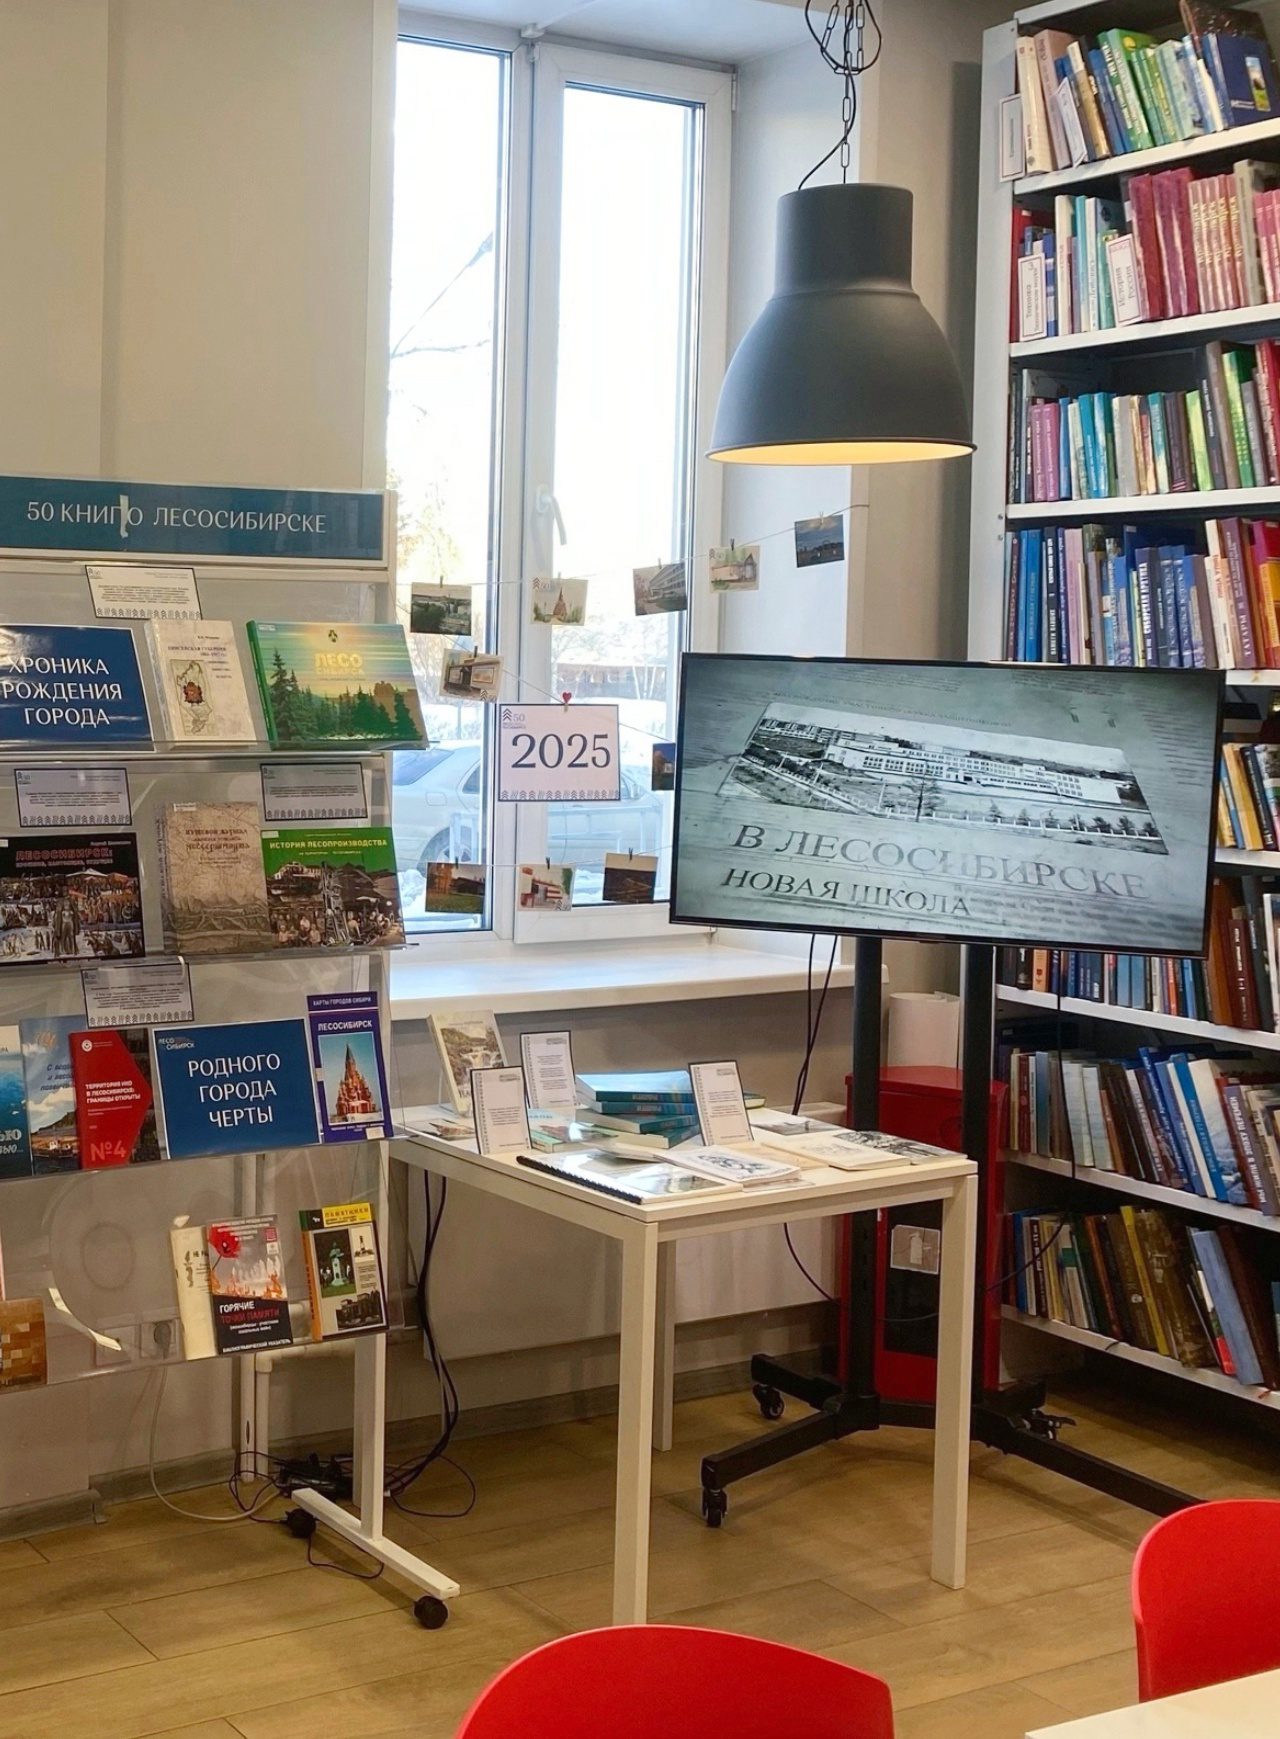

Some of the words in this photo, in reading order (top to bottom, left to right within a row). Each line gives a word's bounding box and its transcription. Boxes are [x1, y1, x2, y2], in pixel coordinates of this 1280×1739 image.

[27, 501, 54, 521] 50
[60, 503, 122, 525] КНИГ
[127, 509, 144, 527] О
[153, 506, 326, 534] ЛЕСОСИБИРСКЕ
[1239, 615, 1251, 656] ТАТАРЫ
[9, 657, 109, 675] ХРОНИКА
[314, 652, 363, 668] ЛЕСО
[2, 682, 122, 703] РОЖДЕНИЯ
[24, 708, 110, 727] ГОРОДА
[511, 733, 611, 769] 2025
[269, 841, 306, 849] ИСТОРИЯ
[307, 839, 387, 849] ЛЕСОПРОИЗВОДСТВА
[729, 823, 765, 850] В
[721, 868, 839, 902] НОВАЯ
[849, 883, 973, 917] ШКОЛА
[318, 1020, 372, 1031] ЛЕСОСИБИРСК
[188, 1053, 280, 1078] РОДНОГО
[199, 1080, 277, 1103] ГОРОДА
[209, 1106, 273, 1128] ЧЕРТЫ
[1229, 1096, 1246, 1131] ПЕРЕМЕН
[1238, 1132, 1254, 1156] ЭПОХУ
[1250, 1164, 1262, 1188] ЖИЛИ
[1256, 1189, 1267, 1203] МЫ
[220, 1301, 256, 1314] ГОРЯЧИЕ
